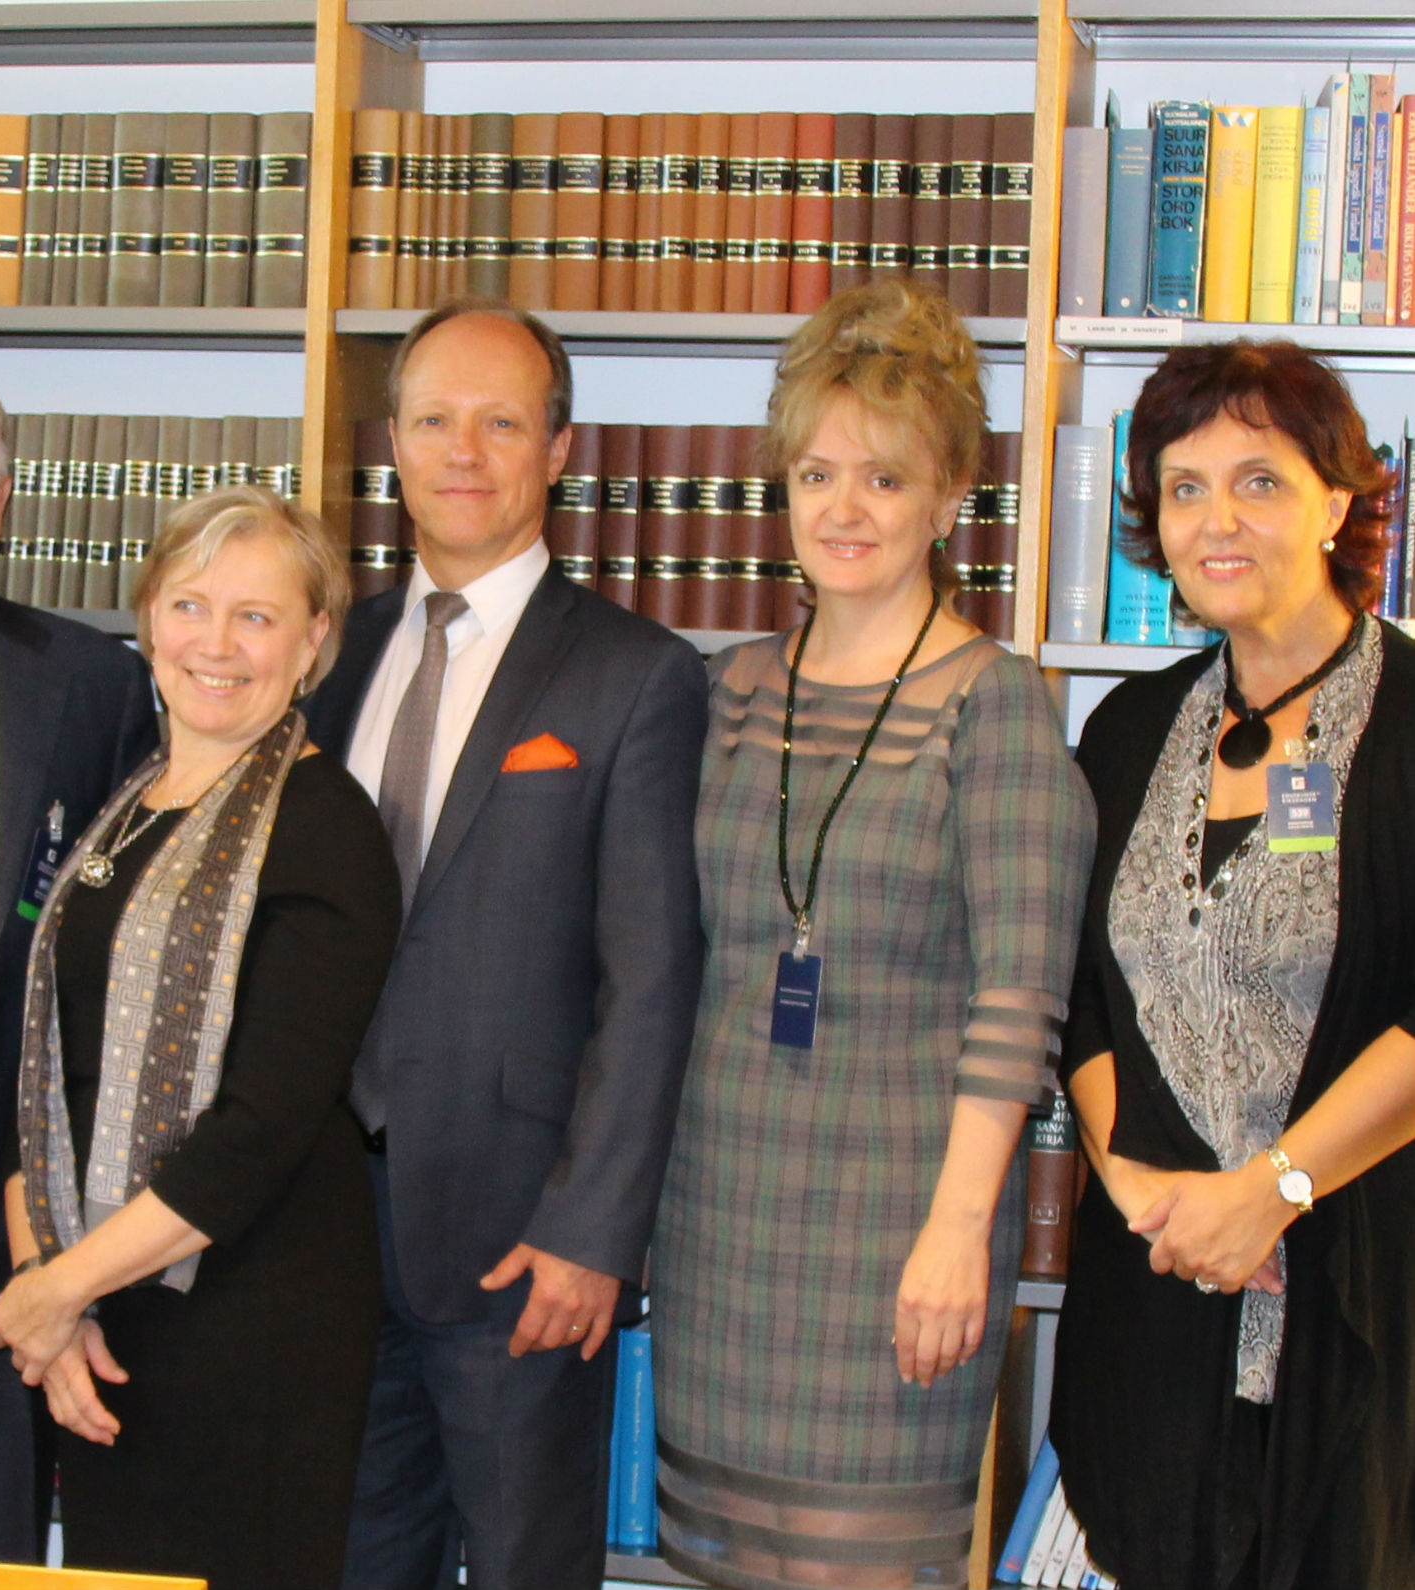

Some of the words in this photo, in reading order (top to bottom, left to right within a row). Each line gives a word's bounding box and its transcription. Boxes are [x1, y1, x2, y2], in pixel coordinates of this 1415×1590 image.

[1164, 127, 1206, 142] SUUR
[1163, 144, 1205, 158] SANA
[1162, 160, 1205, 174] KIRJA
[1162, 184, 1204, 199] STOR
[1161, 201, 1195, 214] ORD
[1160, 217, 1193, 230] BOK
[1036, 1121, 1066, 1134] SANA
[1035, 1134, 1065, 1146] KIRJA
